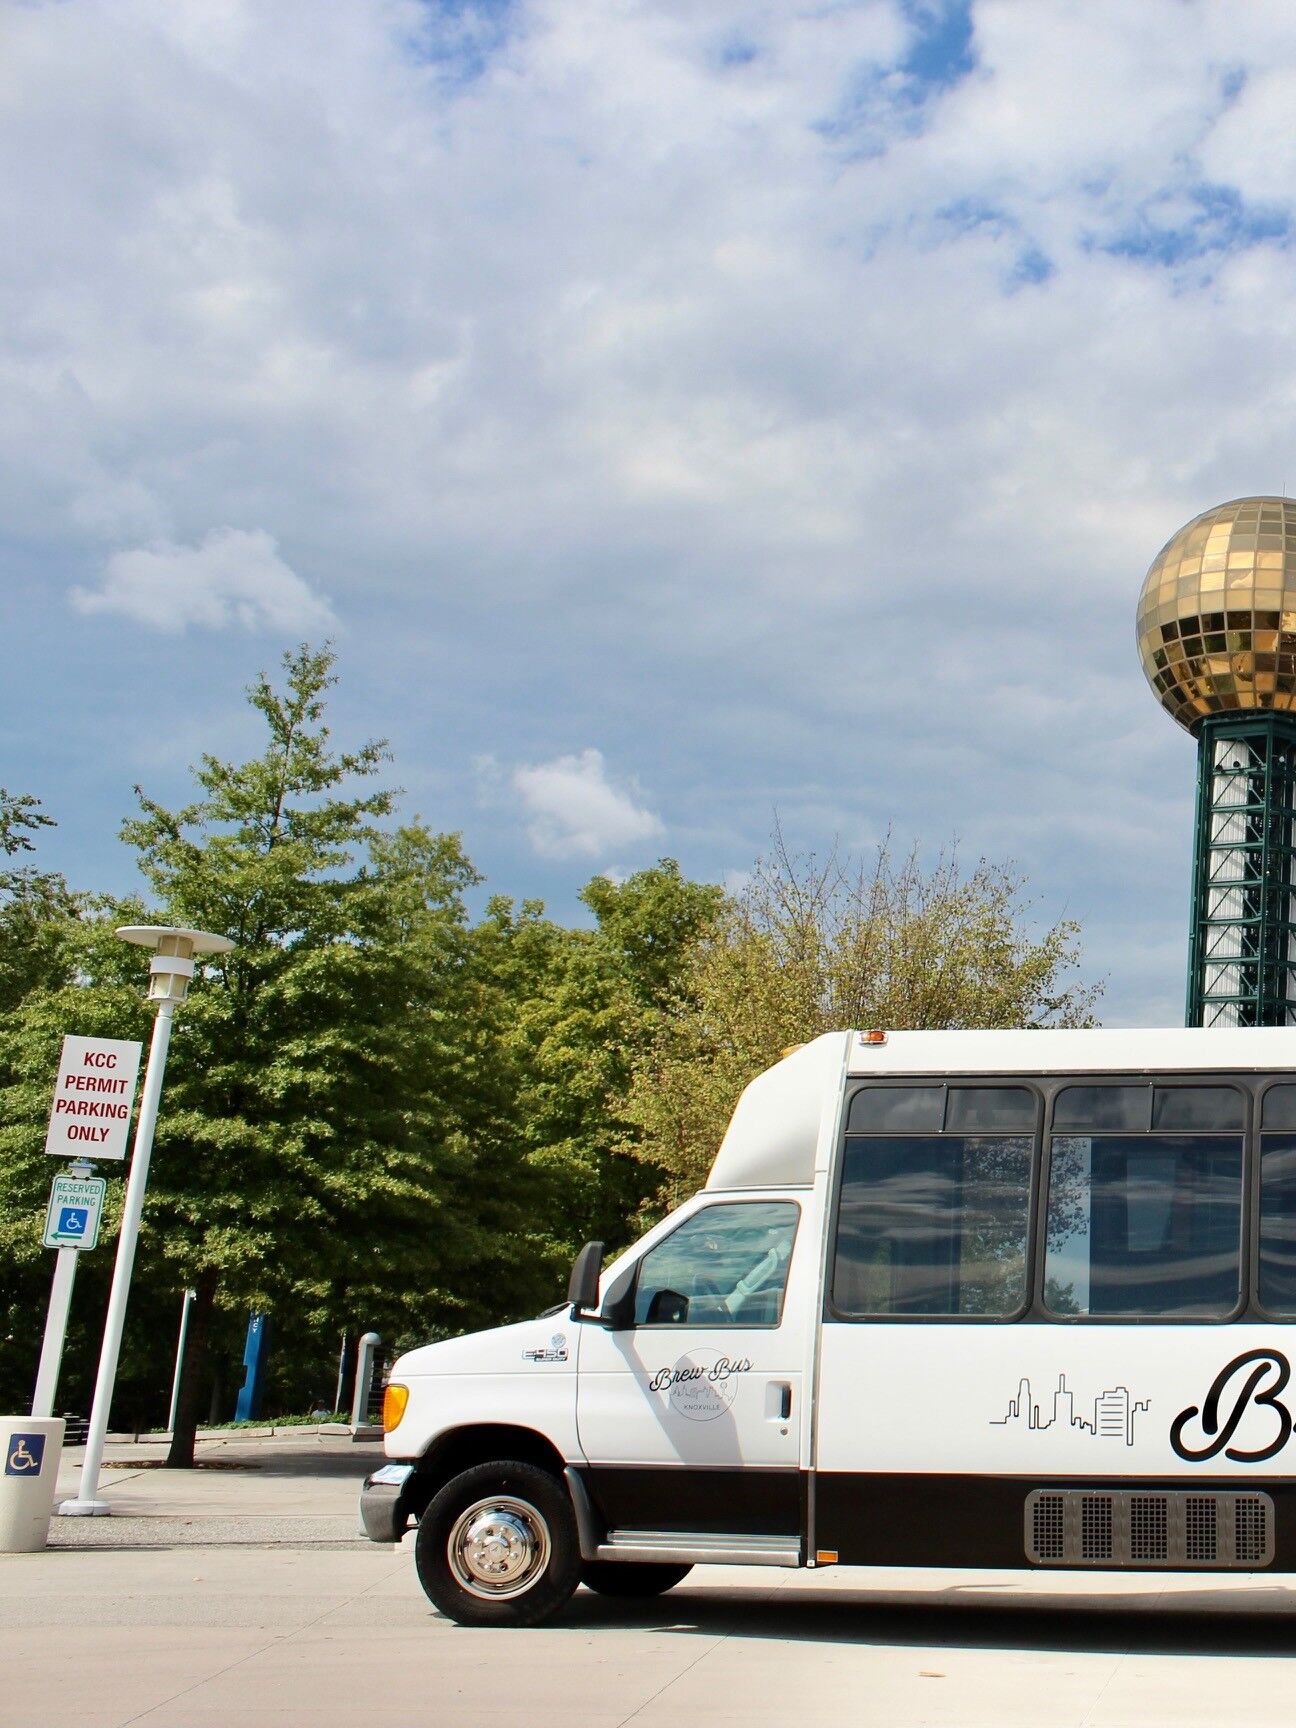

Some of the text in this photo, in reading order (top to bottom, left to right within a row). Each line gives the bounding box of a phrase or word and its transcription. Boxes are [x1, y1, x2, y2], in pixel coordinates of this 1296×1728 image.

[84, 1052, 117, 1069] KCC
[65, 1075, 128, 1094] PERMIT
[56, 1099, 128, 1120] PARKING
[67, 1125, 110, 1142] ONLY
[56, 1183, 100, 1194] RESERVED
[57, 1195, 96, 1206] PARKING
[649, 1357, 754, 1392] Brew Bus
